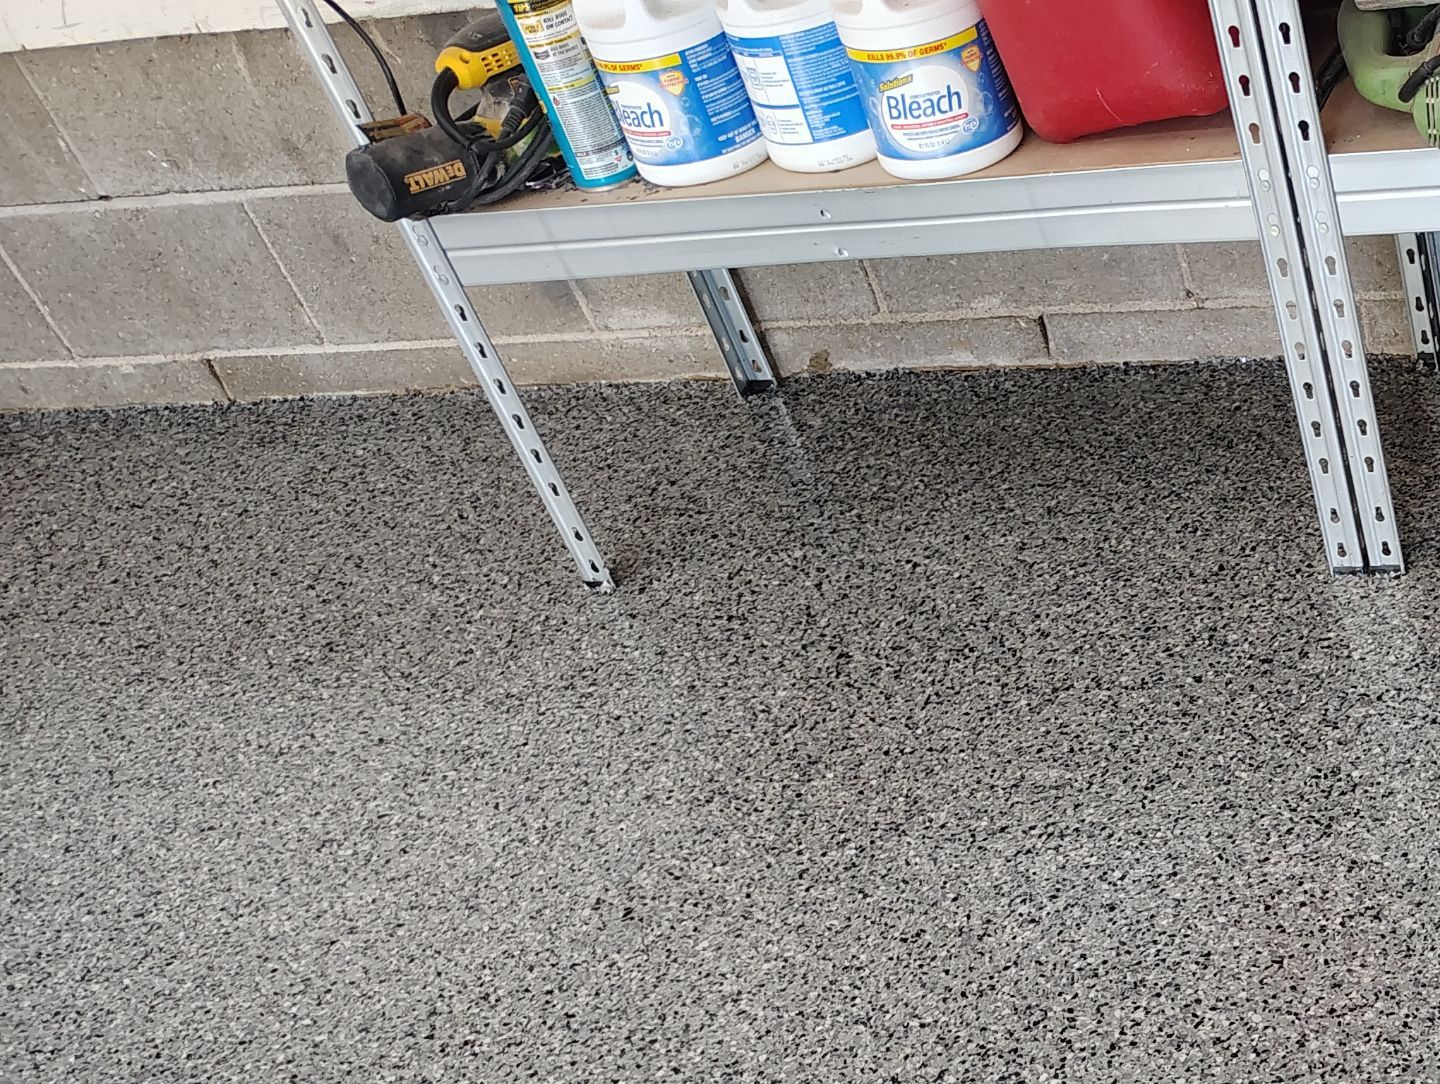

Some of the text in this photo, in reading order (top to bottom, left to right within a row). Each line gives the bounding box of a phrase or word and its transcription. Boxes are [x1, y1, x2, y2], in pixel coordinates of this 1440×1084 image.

[908, 50, 917, 58] OF
[611, 100, 664, 128] leach
[886, 84, 962, 120] Bleach
